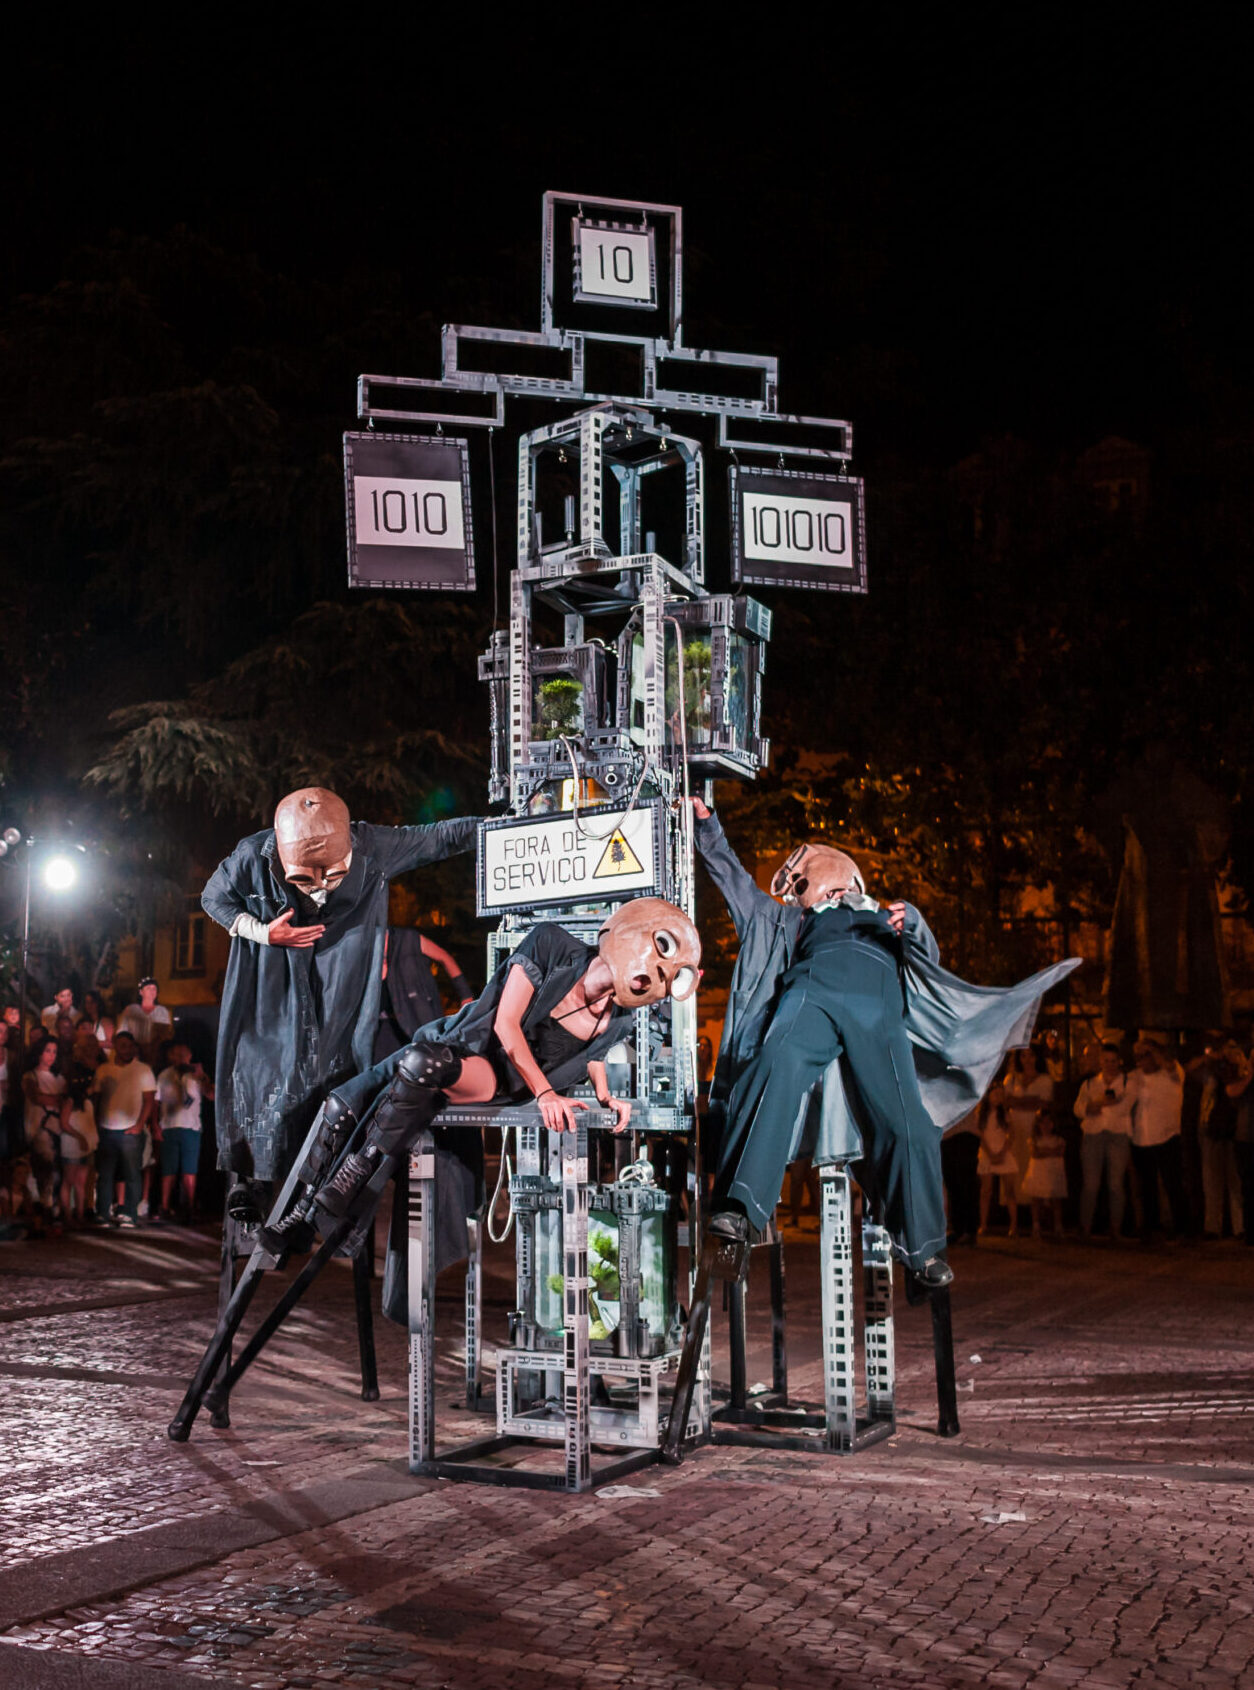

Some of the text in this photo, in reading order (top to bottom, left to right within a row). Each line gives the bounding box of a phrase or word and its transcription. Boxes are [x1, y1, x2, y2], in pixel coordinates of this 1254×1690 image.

[598, 244, 634, 284] 10
[371, 490, 448, 535] 1010
[752, 506, 846, 554] 101010
[504, 829, 587, 860] FORA DE
